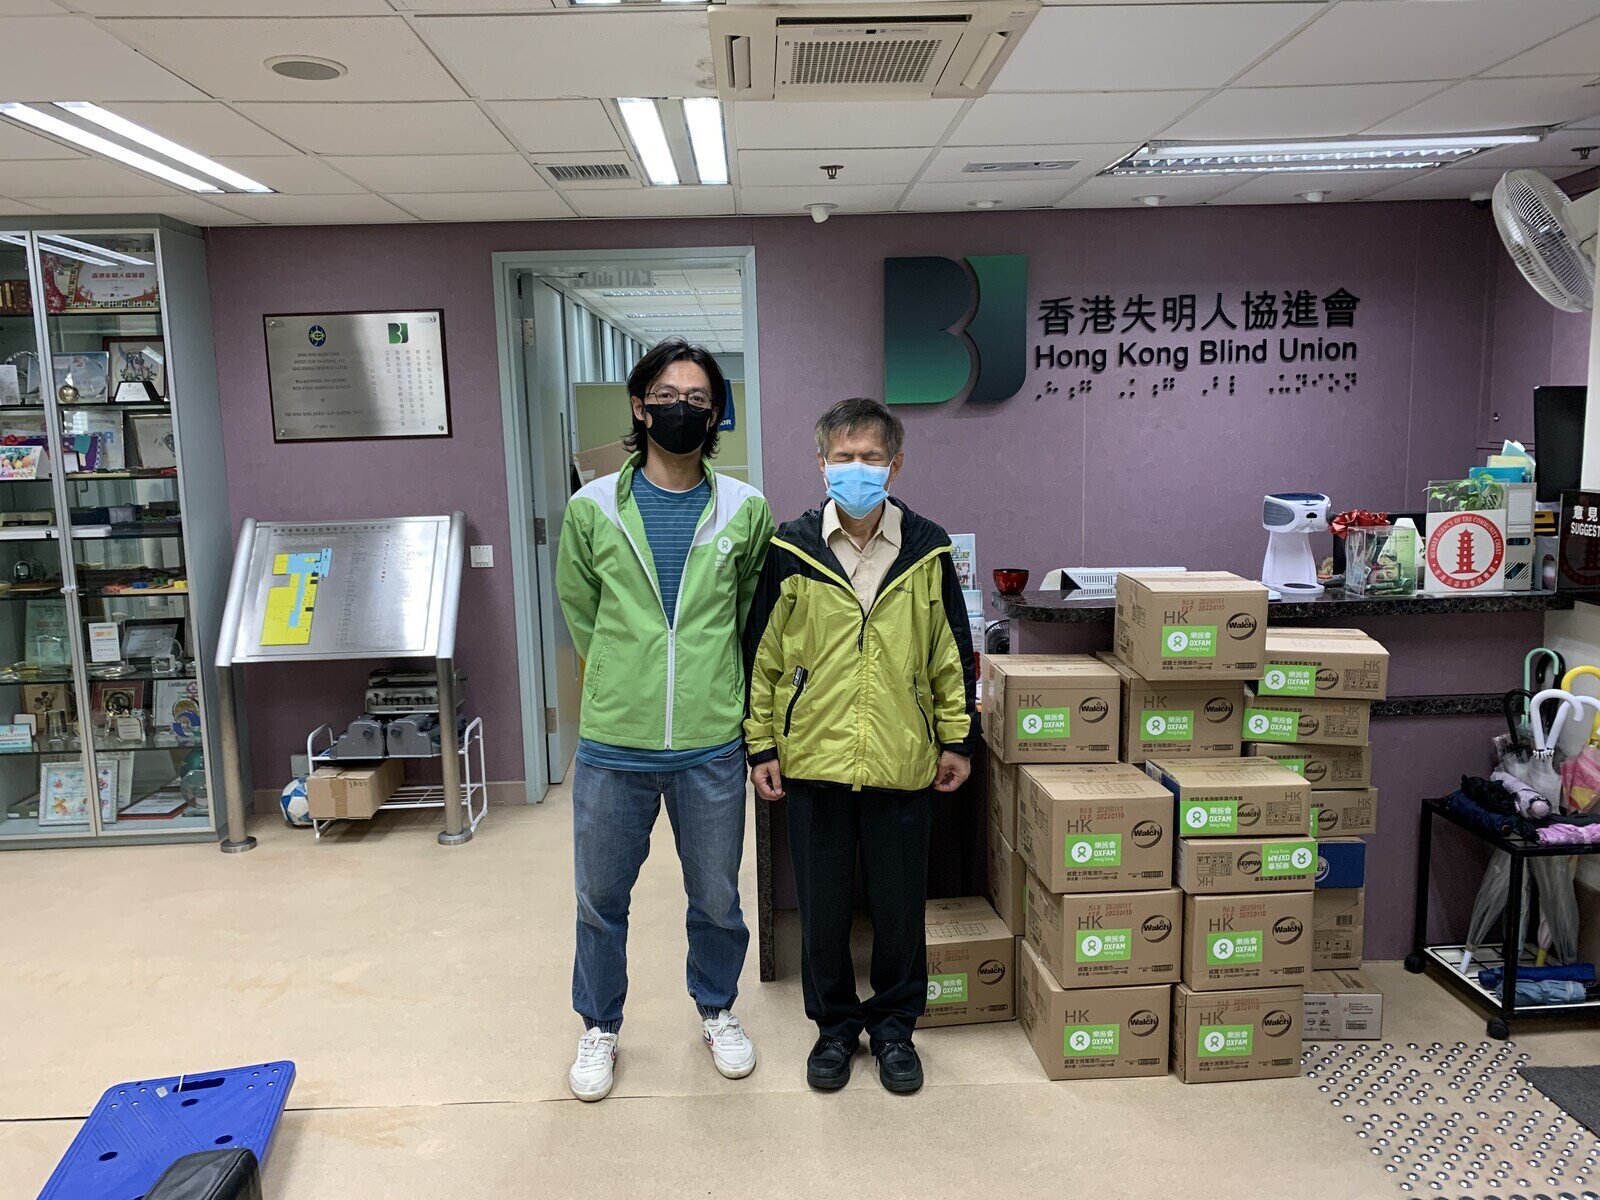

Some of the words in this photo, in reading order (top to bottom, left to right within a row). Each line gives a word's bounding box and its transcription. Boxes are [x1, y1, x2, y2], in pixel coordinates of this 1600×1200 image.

[1038, 287, 1361, 336] 香港失明人協進會
[1035, 344, 1107, 372] Hong
[1119, 342, 1189, 369] Kong
[1200, 339, 1267, 364] Blind
[1279, 337, 1357, 362] Union
[1572, 505, 1598, 522] 意見
[1473, 516, 1499, 538] COMMUNITY
[1164, 611, 1189, 624] HK
[1228, 620, 1255, 629] Walch
[1363, 660, 1381, 669] HK
[1287, 678, 1309, 686] OXFAM
[1019, 694, 1042, 707] HK
[1144, 696, 1167, 708] HK
[1344, 706, 1359, 715] HK
[1270, 724, 1292, 732] OXFAM
[1349, 751, 1363, 760] HK
[1285, 792, 1301, 800] HK
[1358, 798, 1371, 807] HK
[1067, 820, 1092, 833] HK
[1198, 877, 1214, 886] HK
[1078, 915, 1103, 929] HK
[1209, 918, 1234, 931] HK
[1235, 945, 1257, 953] OXFAM
[1065, 1010, 1089, 1023] HK
[1200, 1011, 1224, 1025] HK
